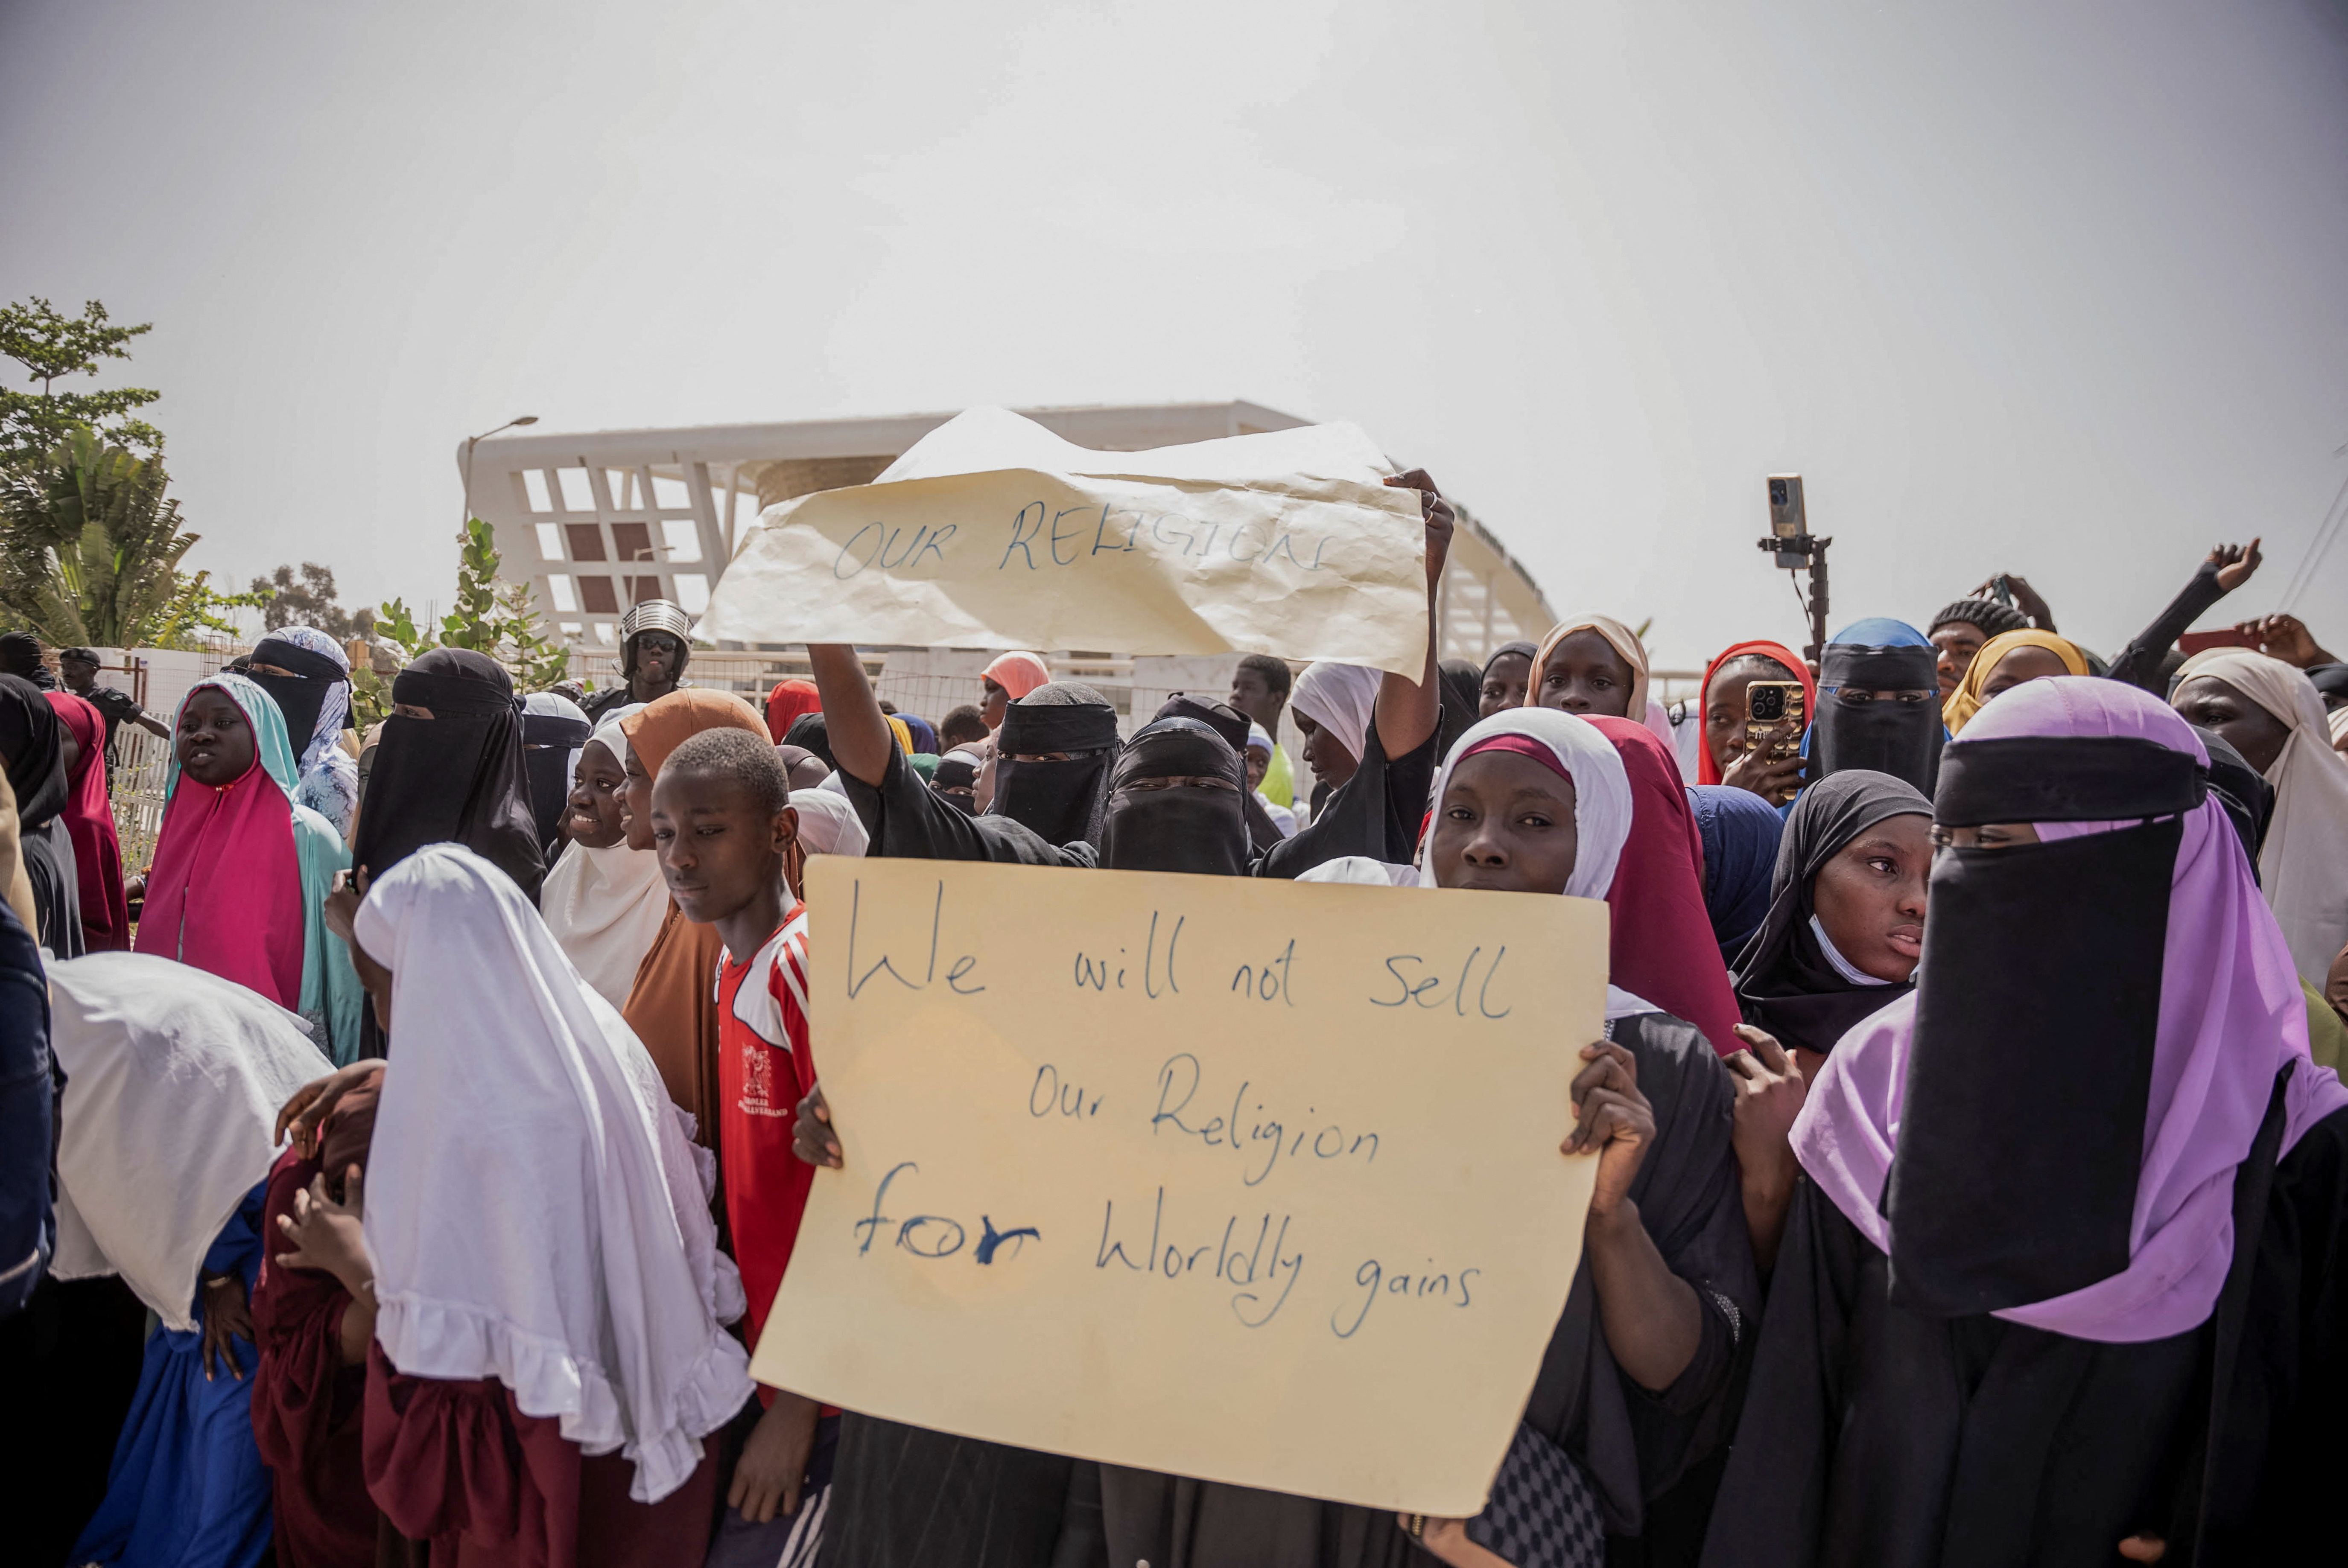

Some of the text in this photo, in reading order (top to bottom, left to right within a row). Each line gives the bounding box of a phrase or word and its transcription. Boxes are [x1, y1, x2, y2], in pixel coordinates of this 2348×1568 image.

[834, 500, 1338, 580] OUR RELIGION
[847, 880, 986, 999] We
[1074, 910, 1186, 1000] will
[1231, 938, 1299, 1006] not
[1151, 1053, 1379, 1186] Religion
[855, 1162, 1481, 1338] for Worldly gains
